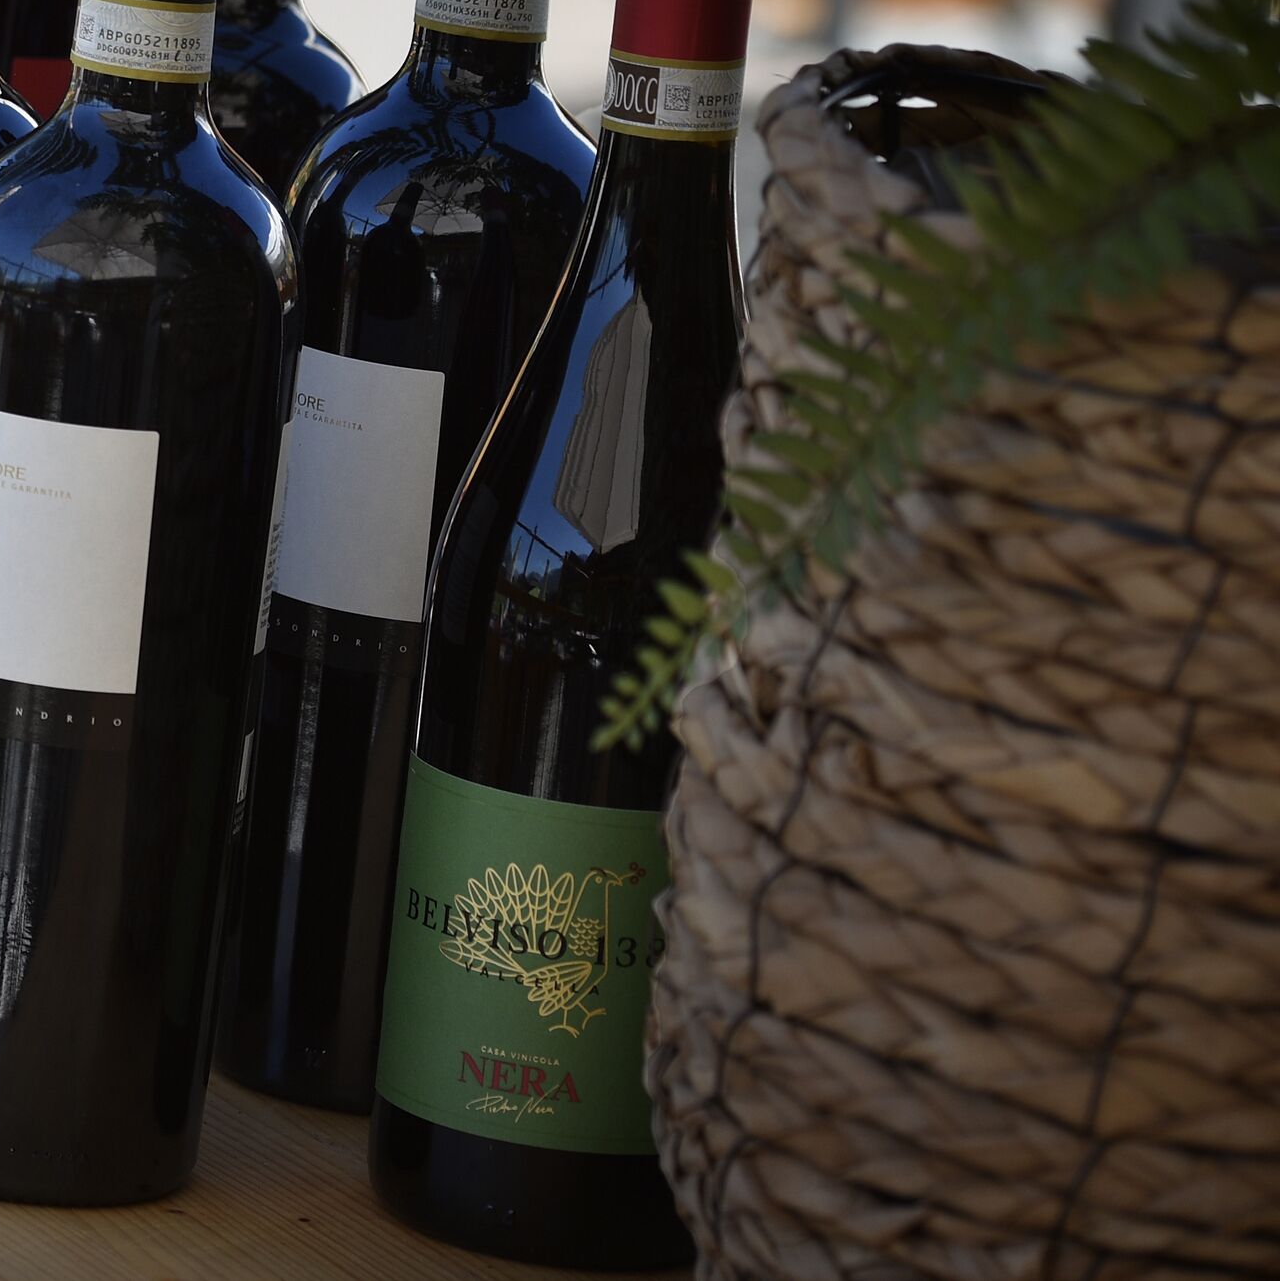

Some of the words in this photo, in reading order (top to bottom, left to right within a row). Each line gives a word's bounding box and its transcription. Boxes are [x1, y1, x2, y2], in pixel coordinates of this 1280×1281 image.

[614, 71, 658, 116] DOCG
[407, 888, 568, 960] BELVISO
[465, 962, 599, 996] VALGELLA
[457, 1050, 581, 1103] NERA
[481, 1045, 506, 1057] CASA
[510, 1051, 560, 1066] VINICOLA
